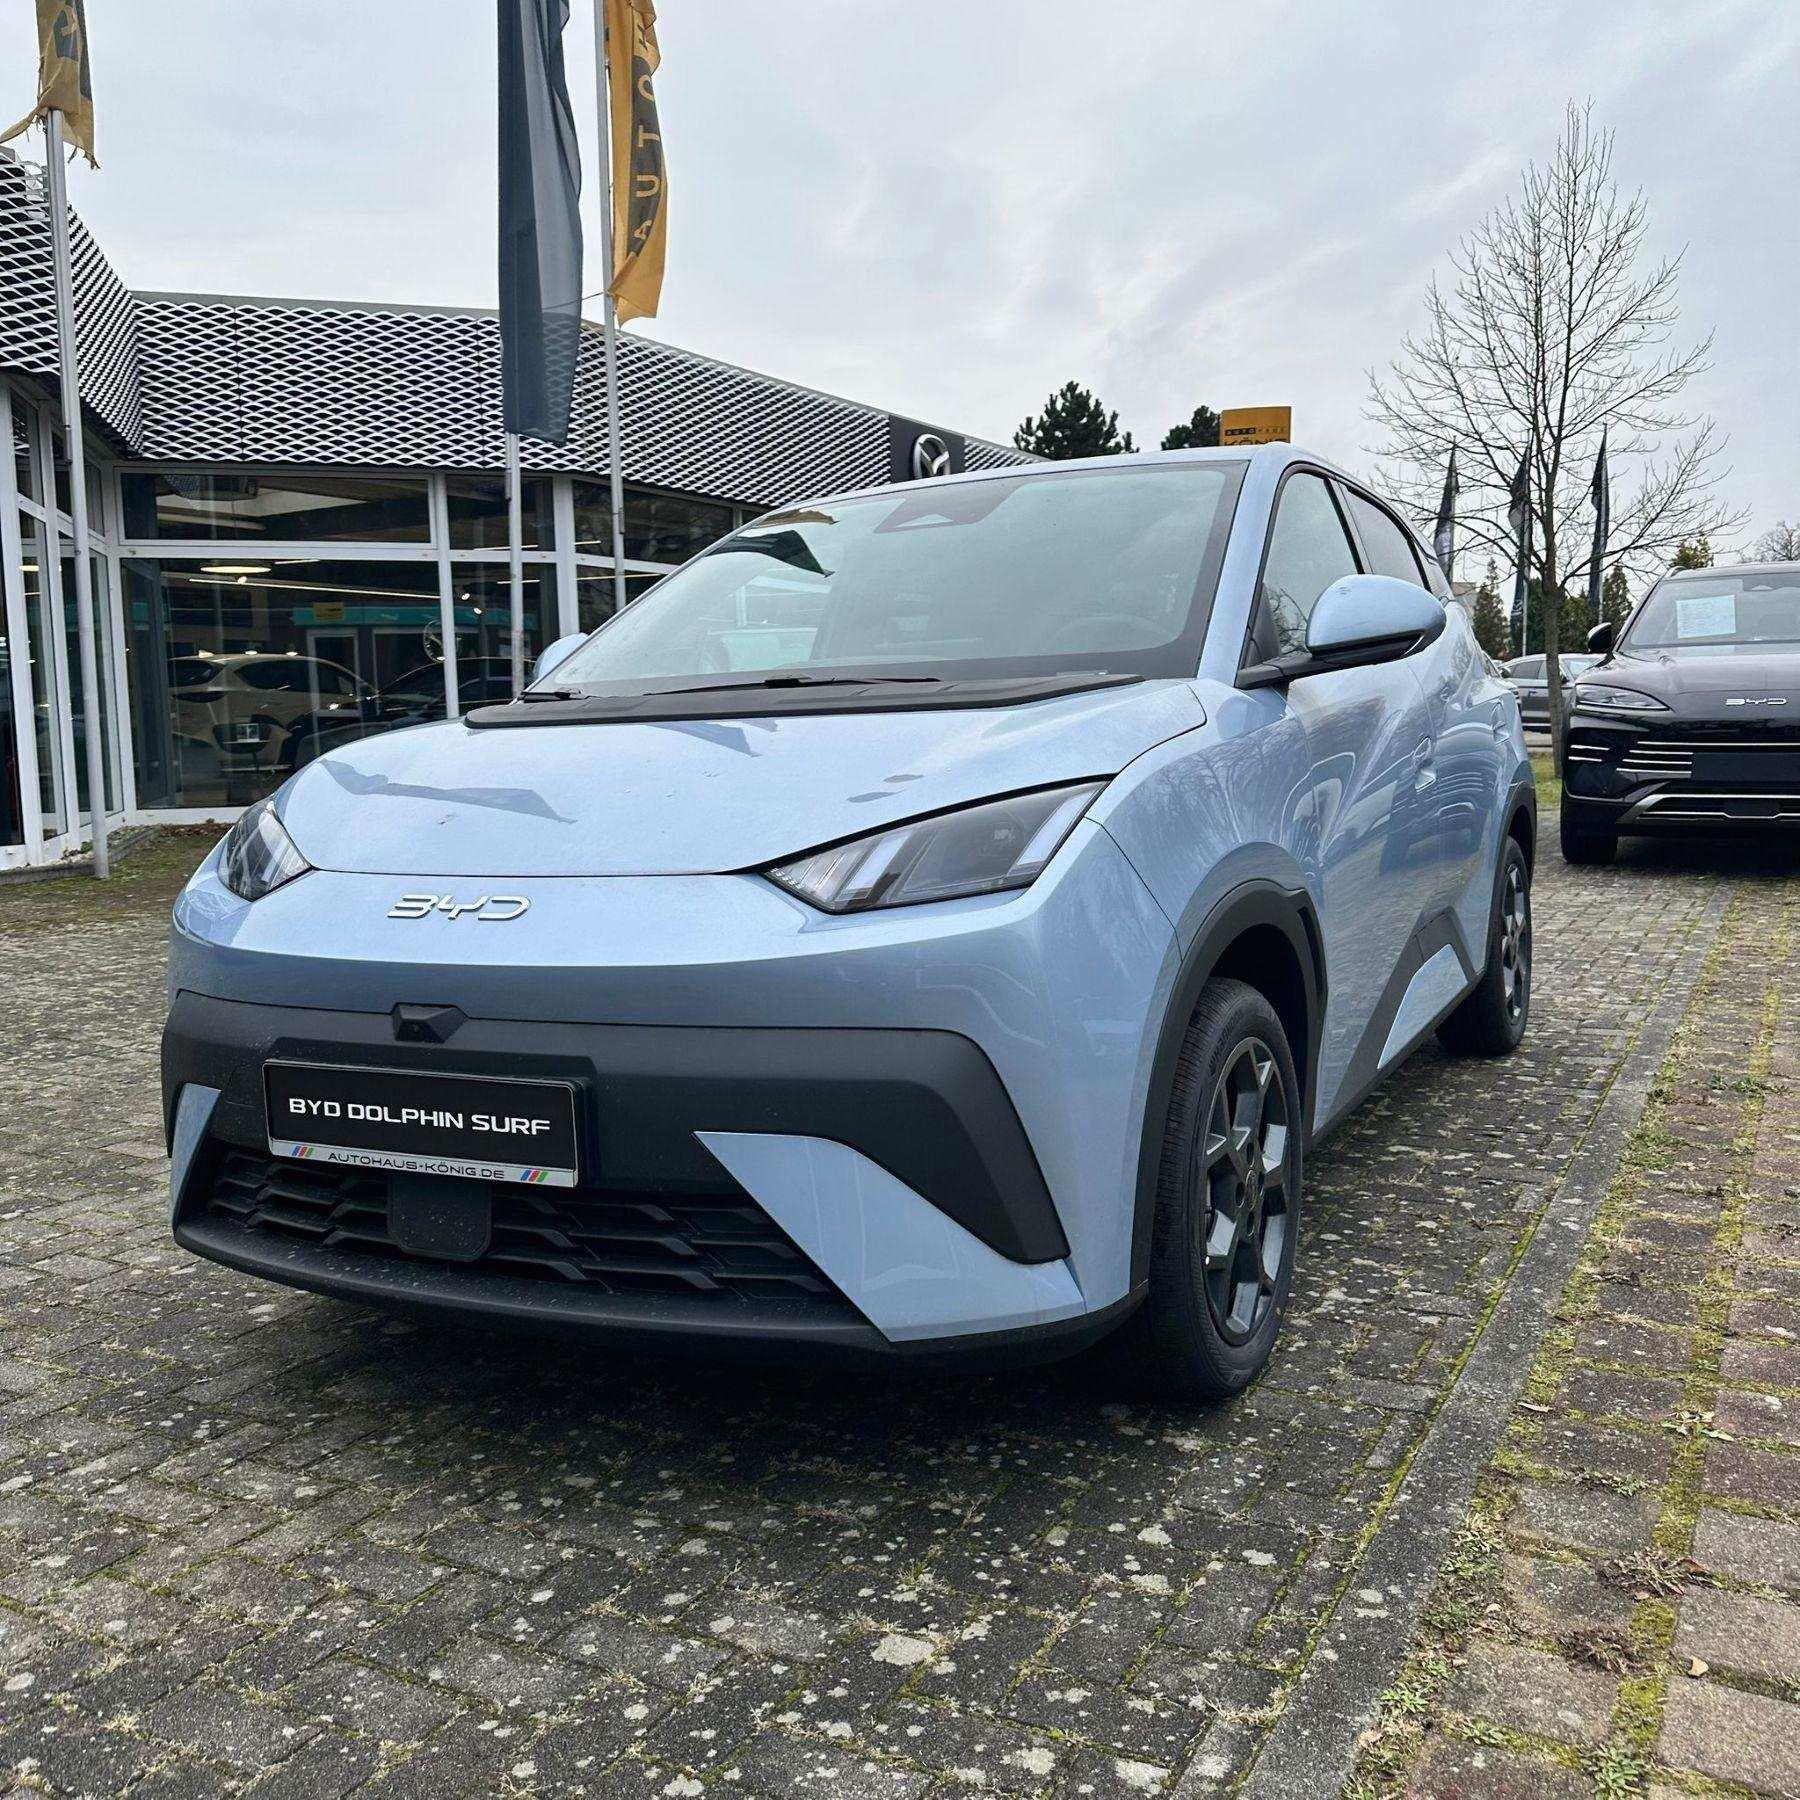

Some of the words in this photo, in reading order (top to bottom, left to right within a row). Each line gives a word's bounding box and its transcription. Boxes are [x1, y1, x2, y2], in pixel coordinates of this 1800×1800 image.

[1726, 698, 1787, 706] BYD
[387, 894, 531, 921] BYD
[289, 1098, 341, 1117] BYD
[347, 1103, 464, 1129] DOLPHIN
[471, 1114, 550, 1135] SURF
[328, 1152, 505, 1179] AUTOHAUS-KÖNIG.DE
